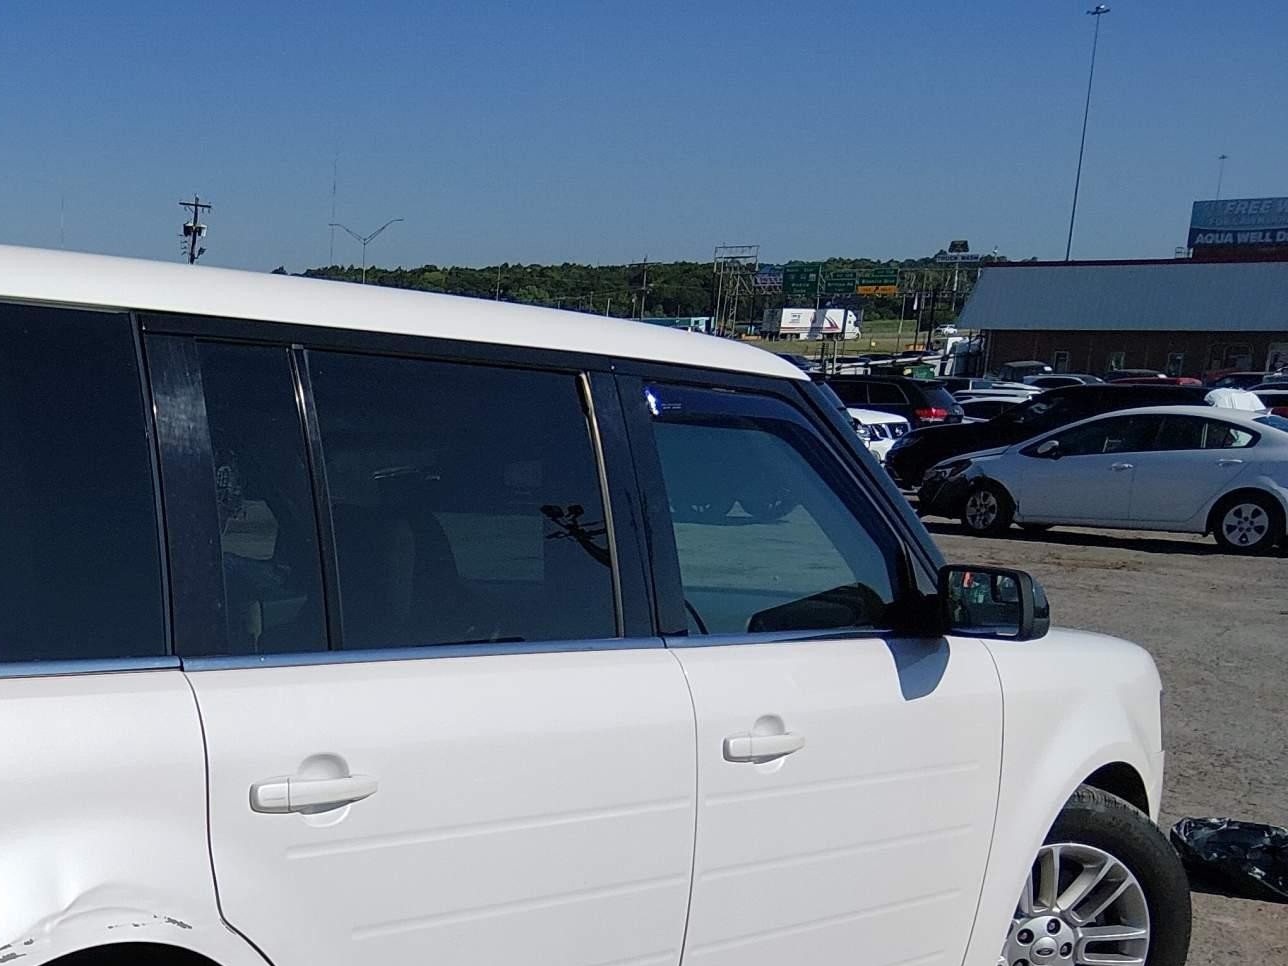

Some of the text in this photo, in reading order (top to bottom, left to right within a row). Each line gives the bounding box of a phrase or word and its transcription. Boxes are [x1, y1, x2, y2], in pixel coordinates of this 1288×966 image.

[1225, 200, 1273, 214] FREE
[1195, 232, 1234, 244] AQUA
[1237, 231, 1272, 243] WELL
